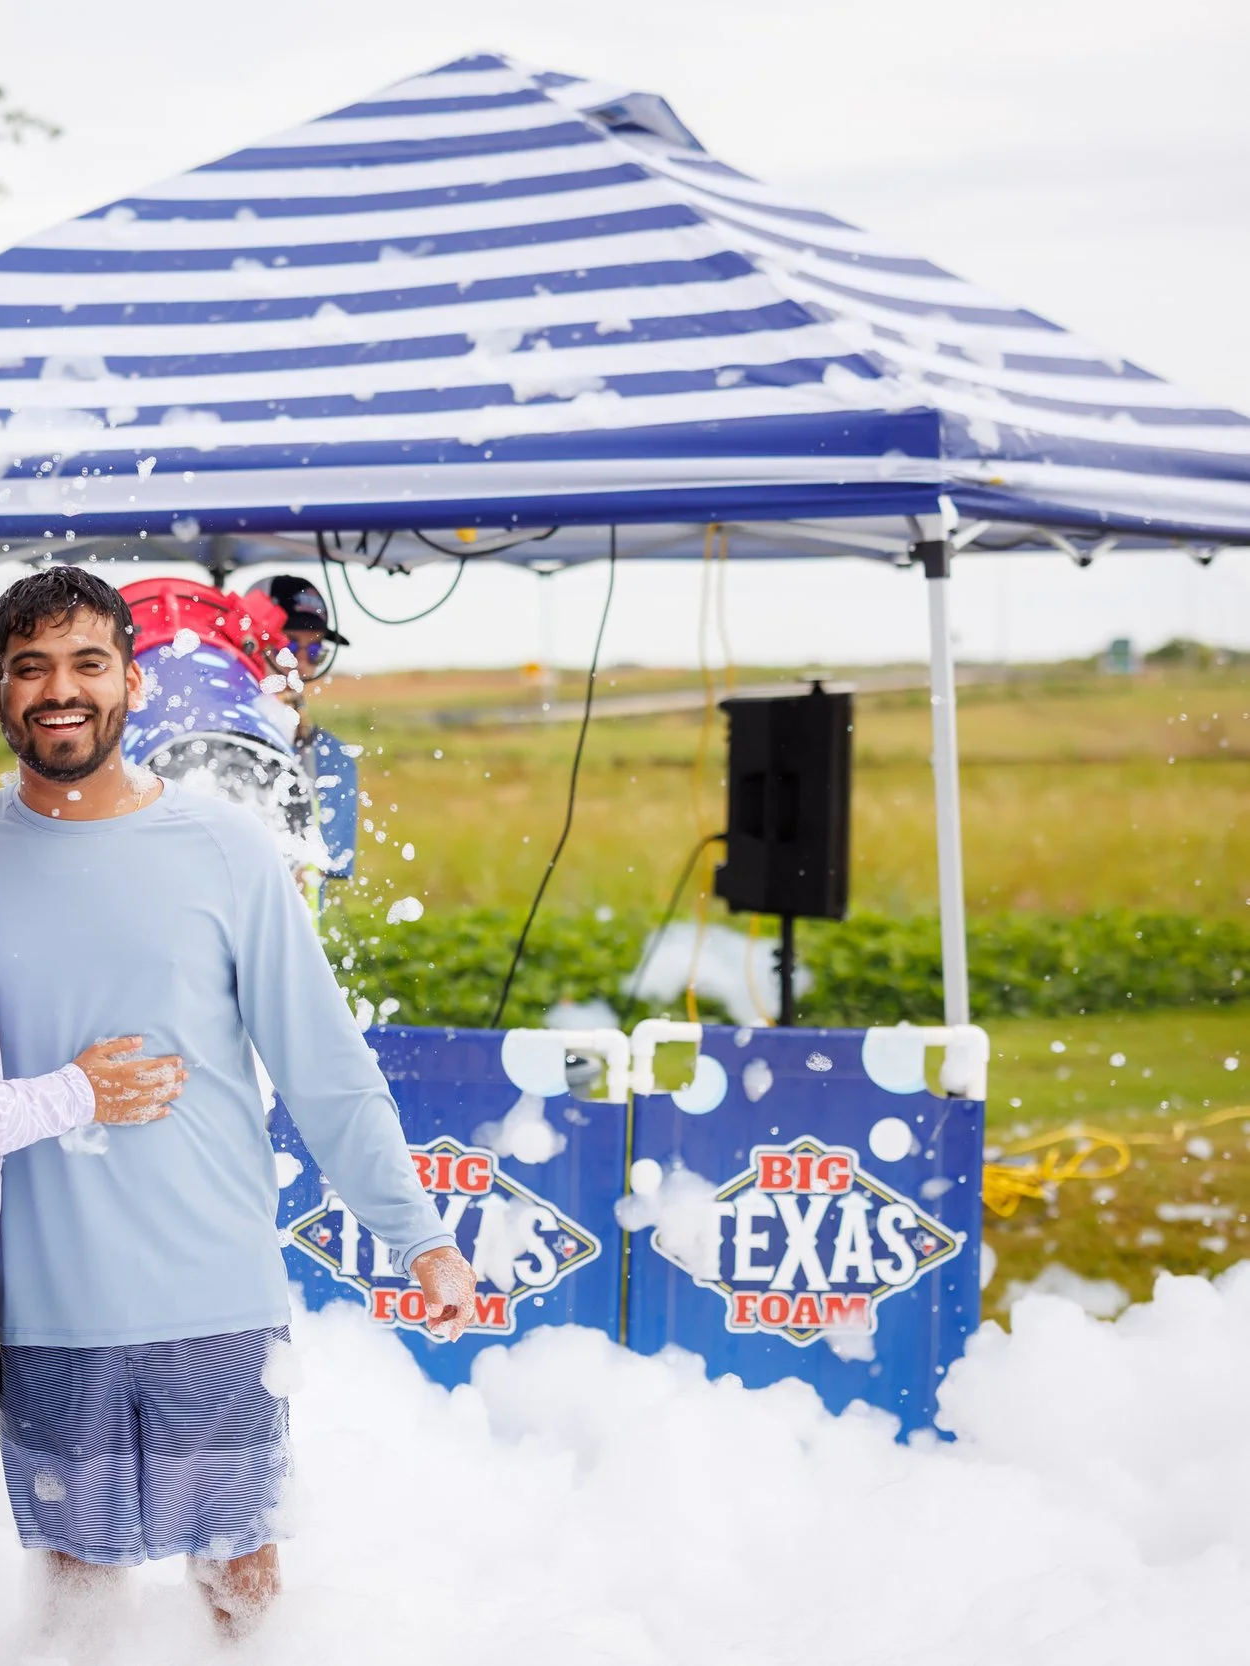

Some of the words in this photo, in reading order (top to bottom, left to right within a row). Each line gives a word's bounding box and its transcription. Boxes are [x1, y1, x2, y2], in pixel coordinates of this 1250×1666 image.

[758, 1155, 851, 1191] BIG
[692, 1191, 918, 1290] TEXAS
[372, 1290, 508, 1326] FOM
[733, 1294, 868, 1327] FOAM
